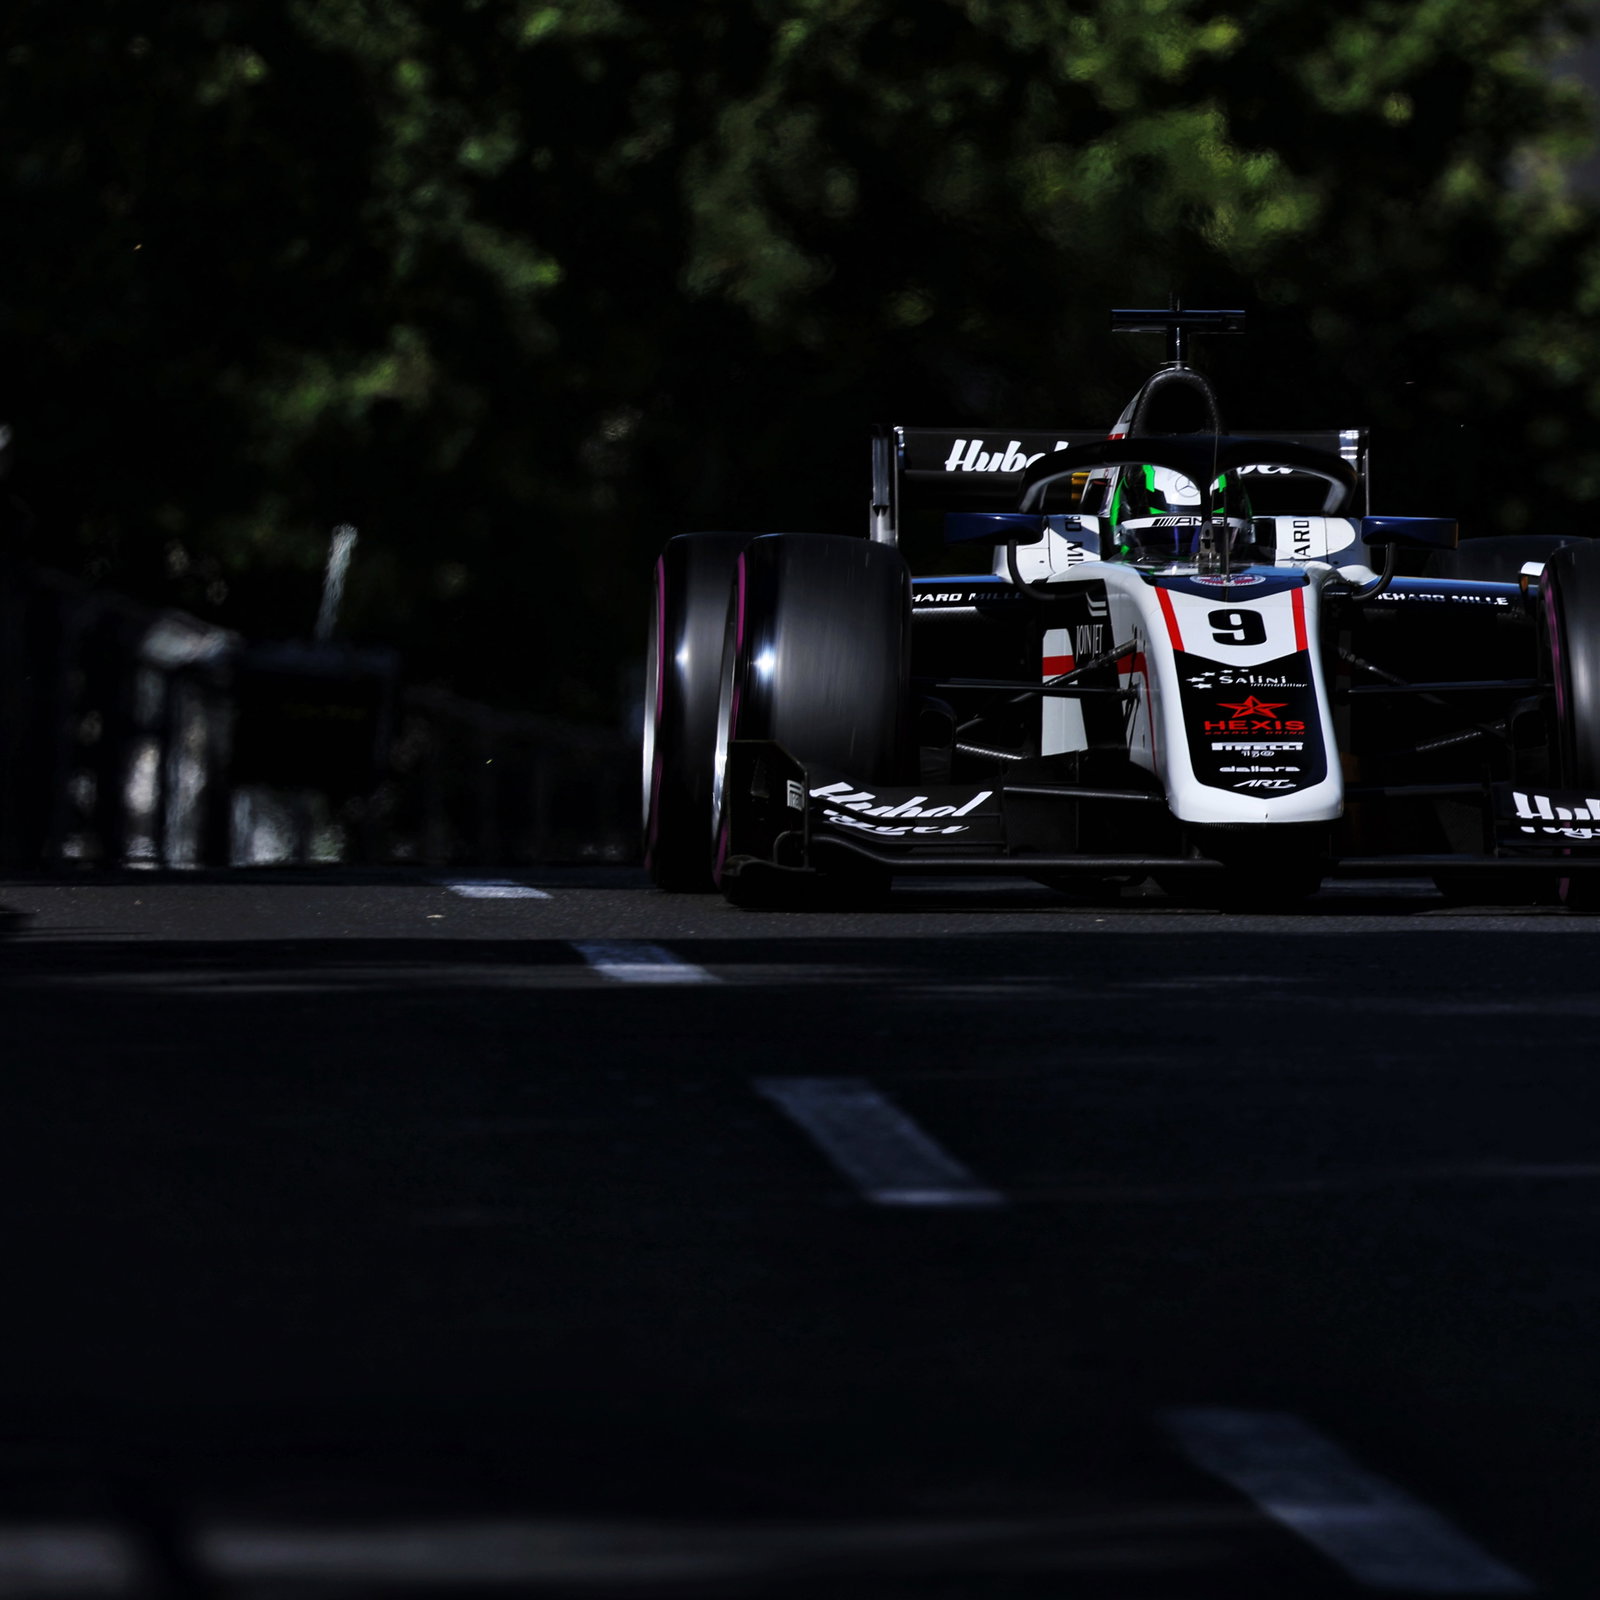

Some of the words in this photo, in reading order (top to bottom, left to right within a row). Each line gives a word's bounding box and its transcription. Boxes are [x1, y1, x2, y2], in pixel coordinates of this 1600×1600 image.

[1451, 594, 1510, 606] MILLE
[1208, 608, 1267, 646] 9
[1203, 720, 1306, 731] HEXIS
[1210, 741, 1304, 751] PIRELLI
[1219, 765, 1301, 773] dallara
